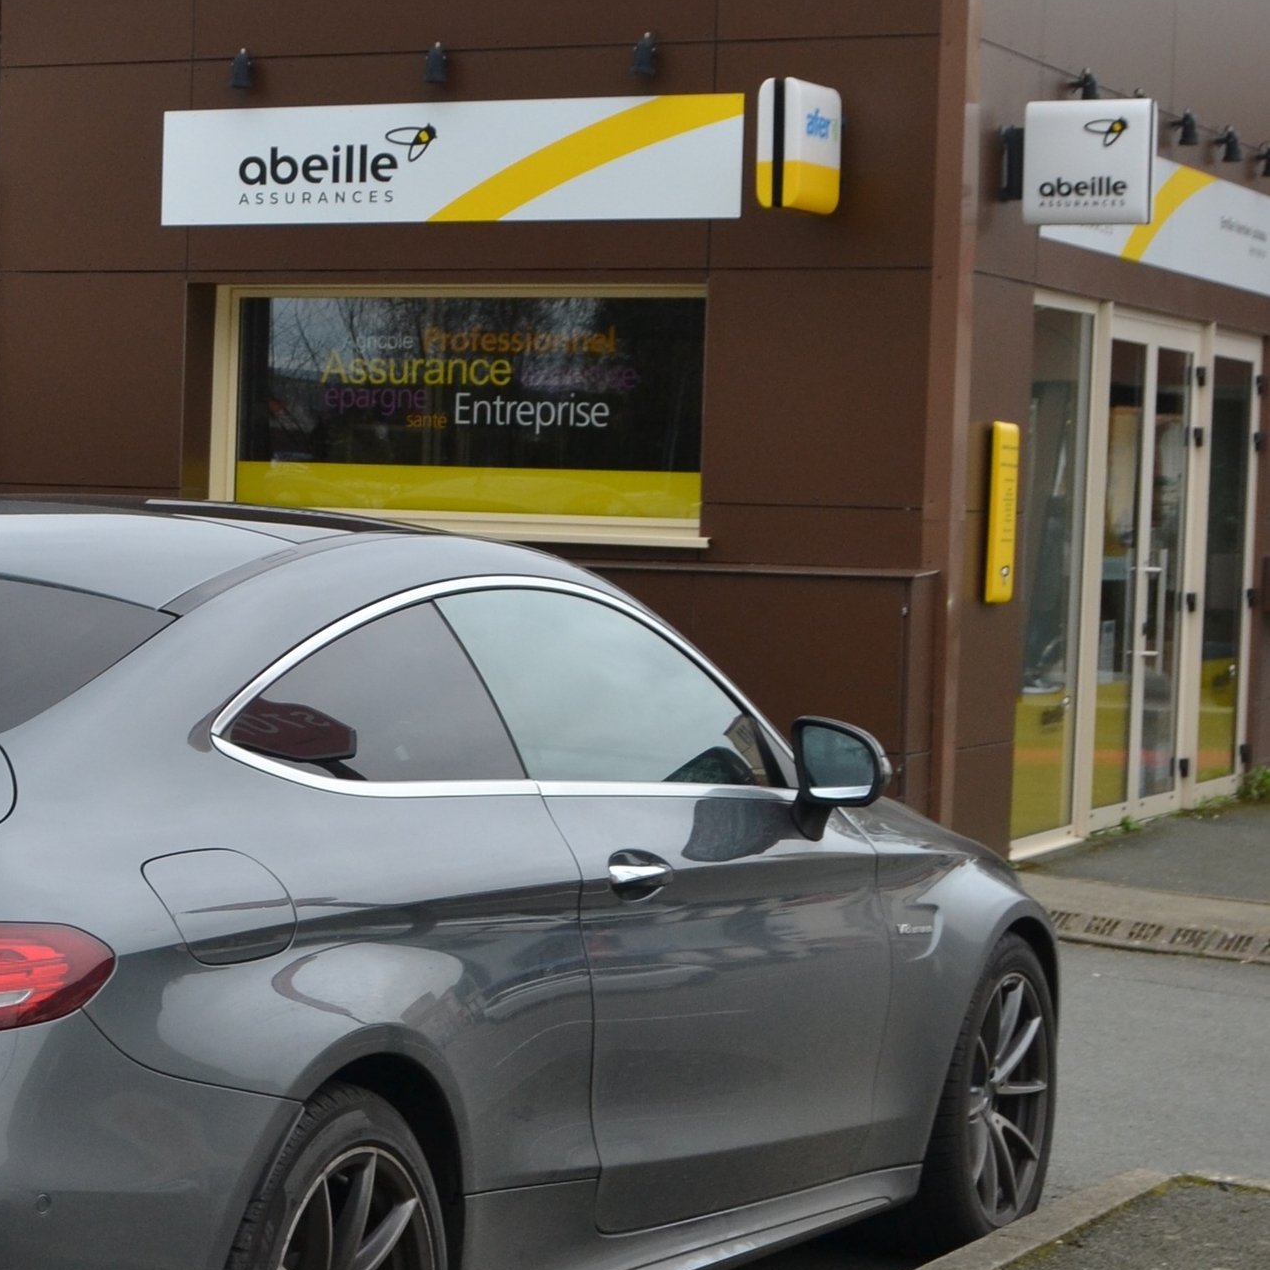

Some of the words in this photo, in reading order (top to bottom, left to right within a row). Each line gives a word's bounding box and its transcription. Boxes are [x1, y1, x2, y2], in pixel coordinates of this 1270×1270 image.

[239, 144, 398, 185] abeille
[238, 190, 394, 205] ASSURANCES
[1039, 176, 1127, 197] abeille
[1038, 199, 1126, 208] ASSURANCES
[321, 352, 512, 385] Assurance
[325, 383, 427, 415] épargne
[406, 412, 447, 428] santé
[455, 392, 610, 434] Entreprise
